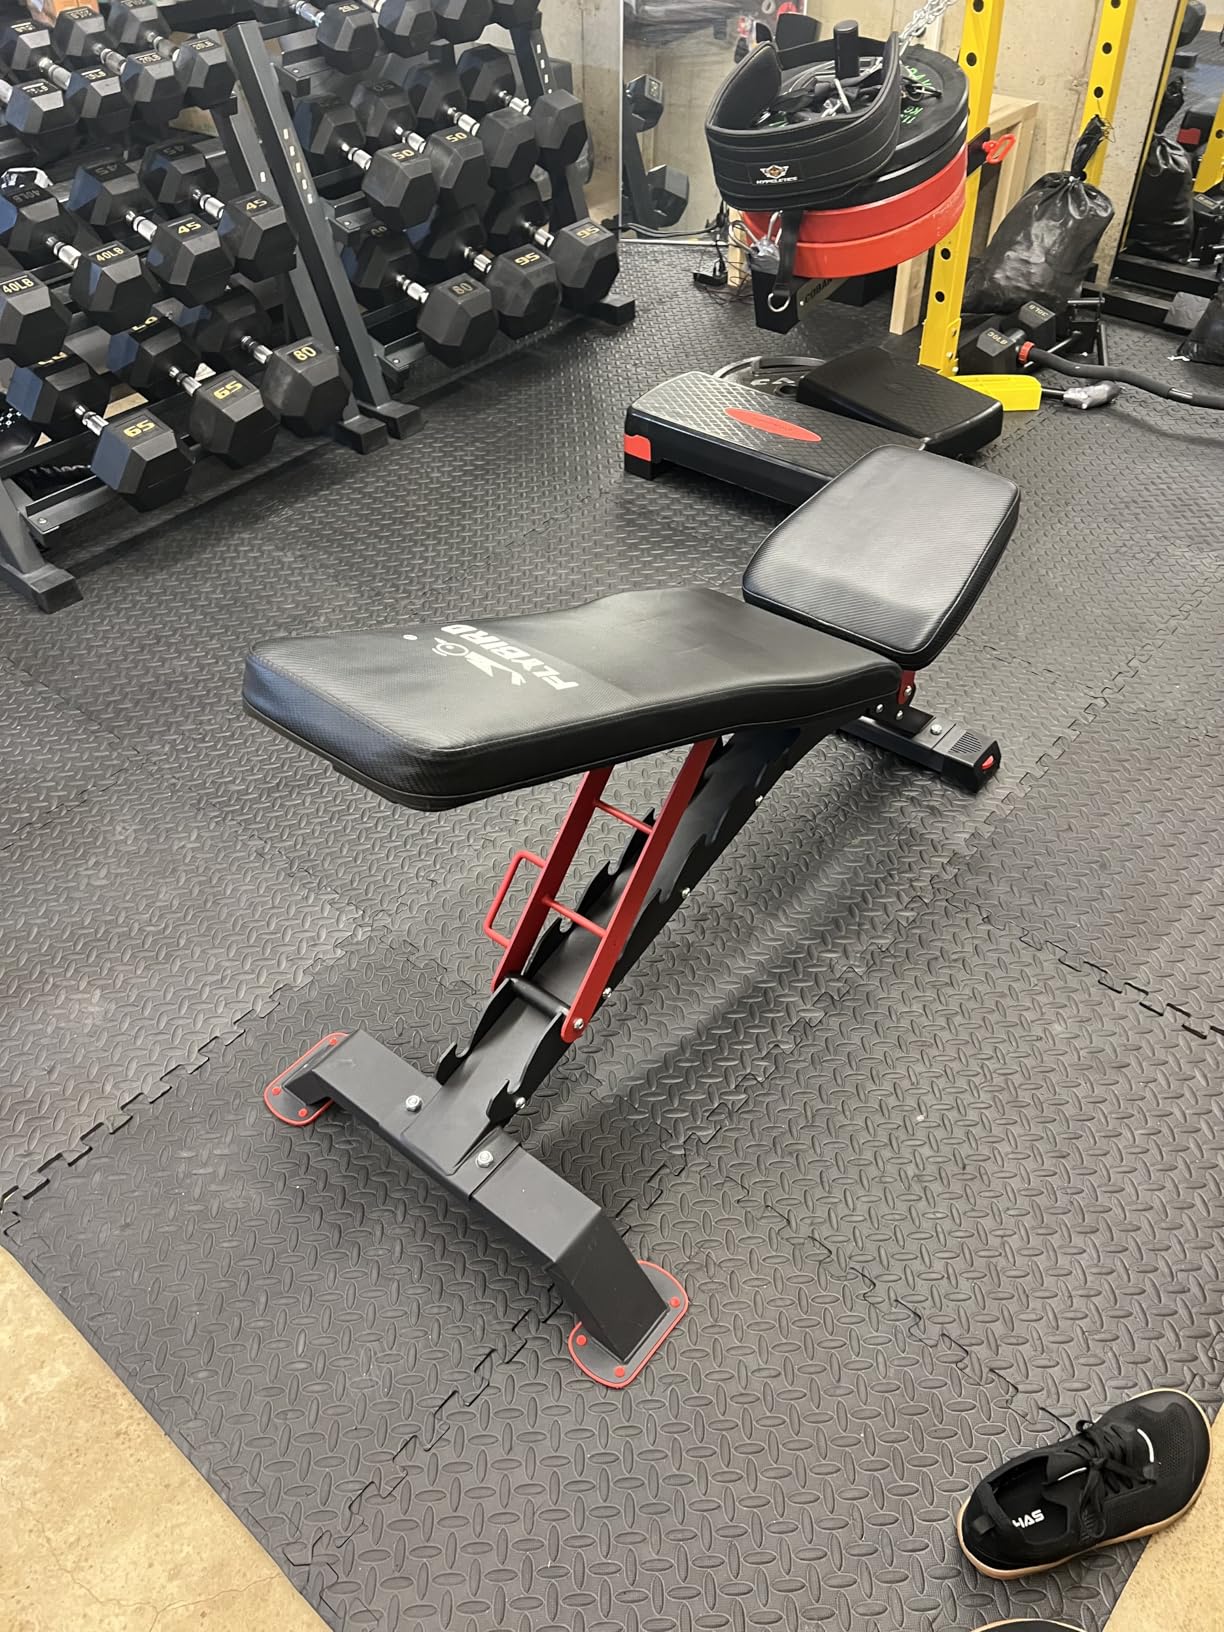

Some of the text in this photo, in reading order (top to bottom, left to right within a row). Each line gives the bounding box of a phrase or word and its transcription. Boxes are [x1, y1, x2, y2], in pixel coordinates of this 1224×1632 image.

[445, 132, 468, 143] 50
[391, 149, 415, 161] 50
[12, 189, 40, 203] 40LB
[244, 198, 268, 212] 45
[177, 221, 201, 234] 45
[575, 225, 600, 239] 95
[95, 245, 125, 263] 40LB
[514, 252, 541, 266] 95
[1, 277, 34, 295] 40LB
[452, 282, 473, 295] 80
[292, 346, 317, 361] 80
[213, 380, 243, 400] 65
[123, 419, 155, 438] 65
[441, 624, 579, 690] FLYBIRD
